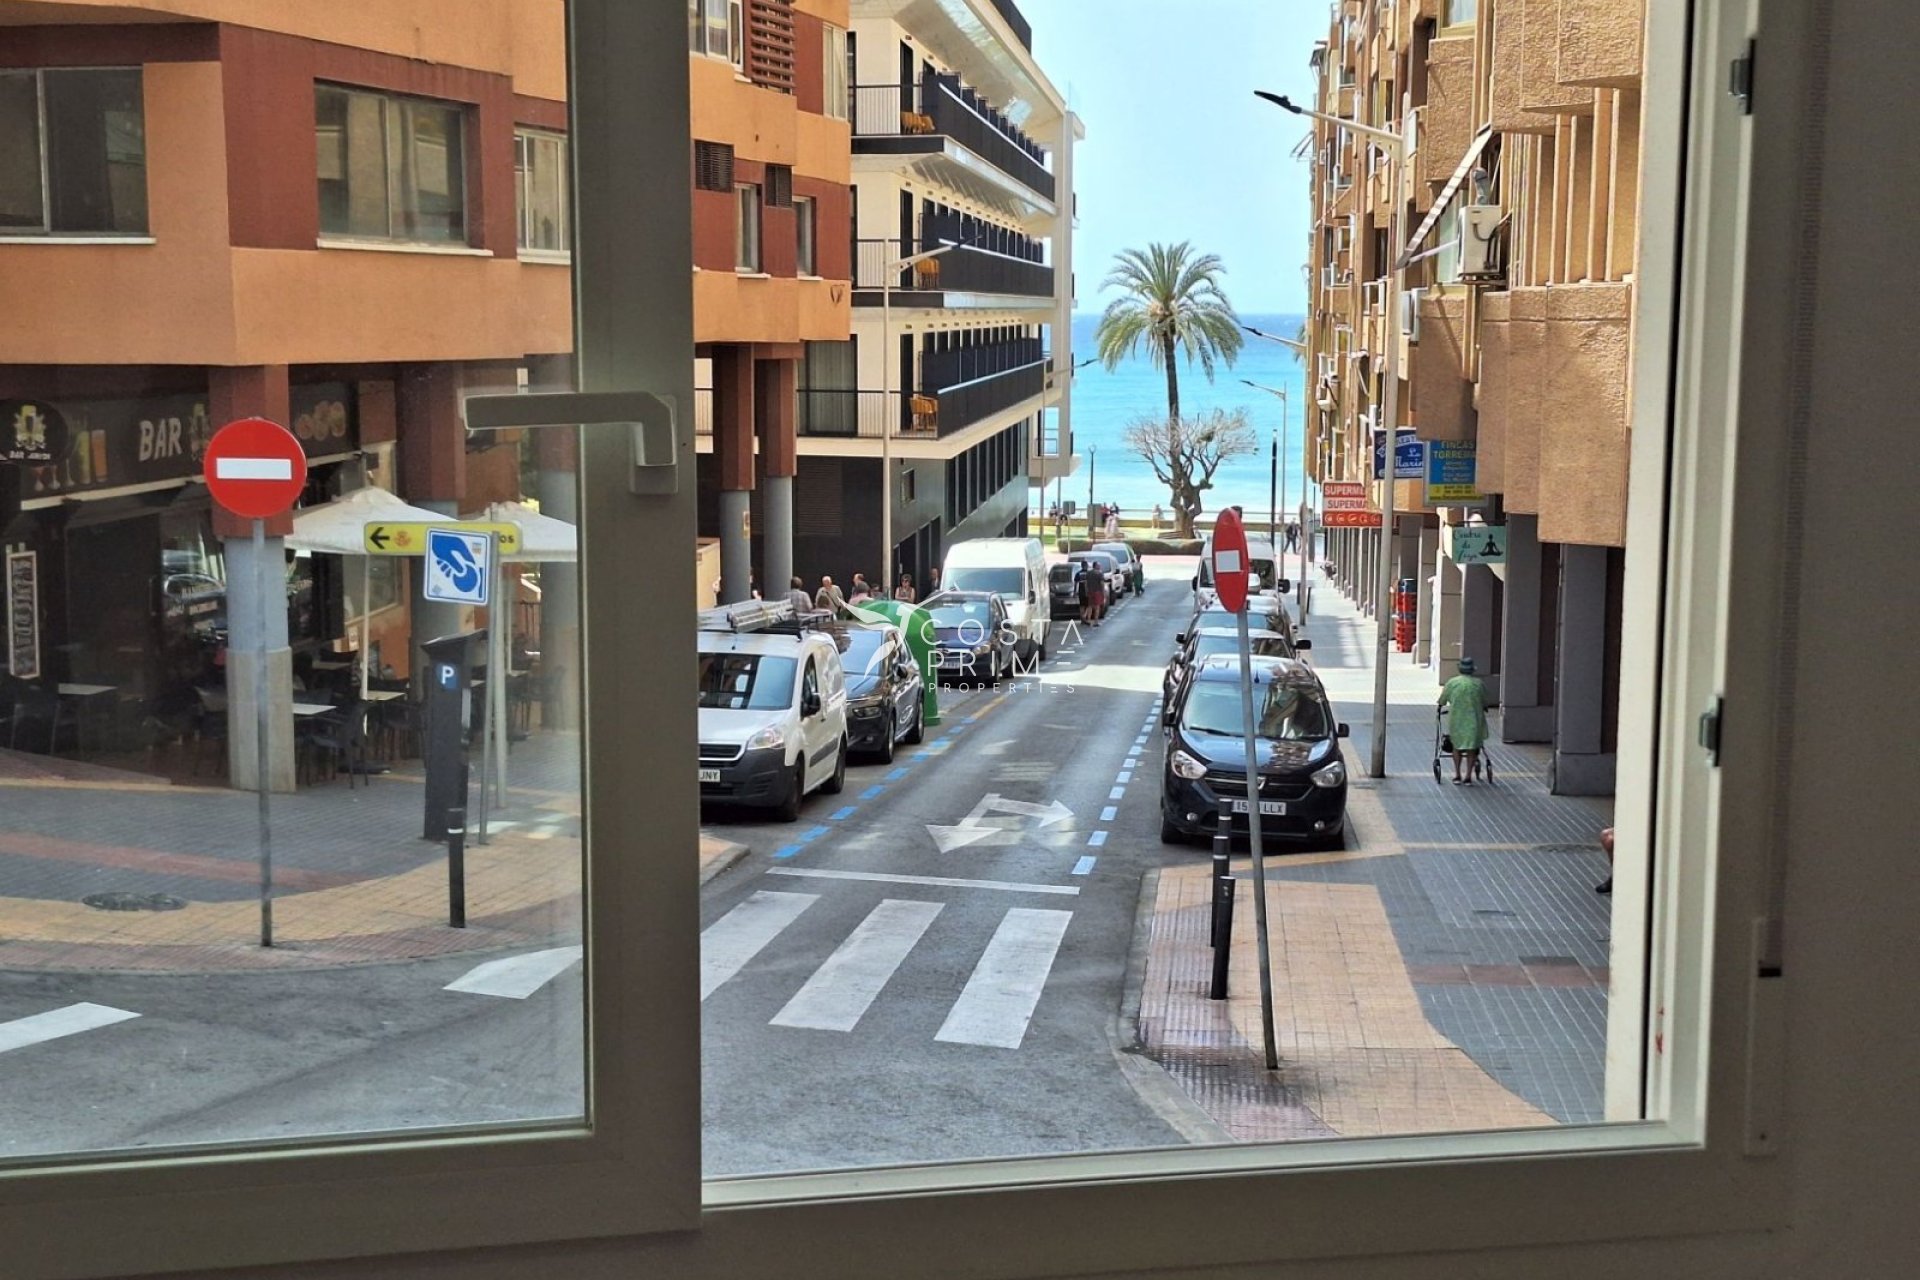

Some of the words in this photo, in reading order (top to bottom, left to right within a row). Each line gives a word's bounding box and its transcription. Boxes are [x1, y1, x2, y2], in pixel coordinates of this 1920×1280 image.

[139, 417, 183, 461] BAR
[1441, 440, 1474, 449] FINCAS
[441, 666, 455, 685] P
